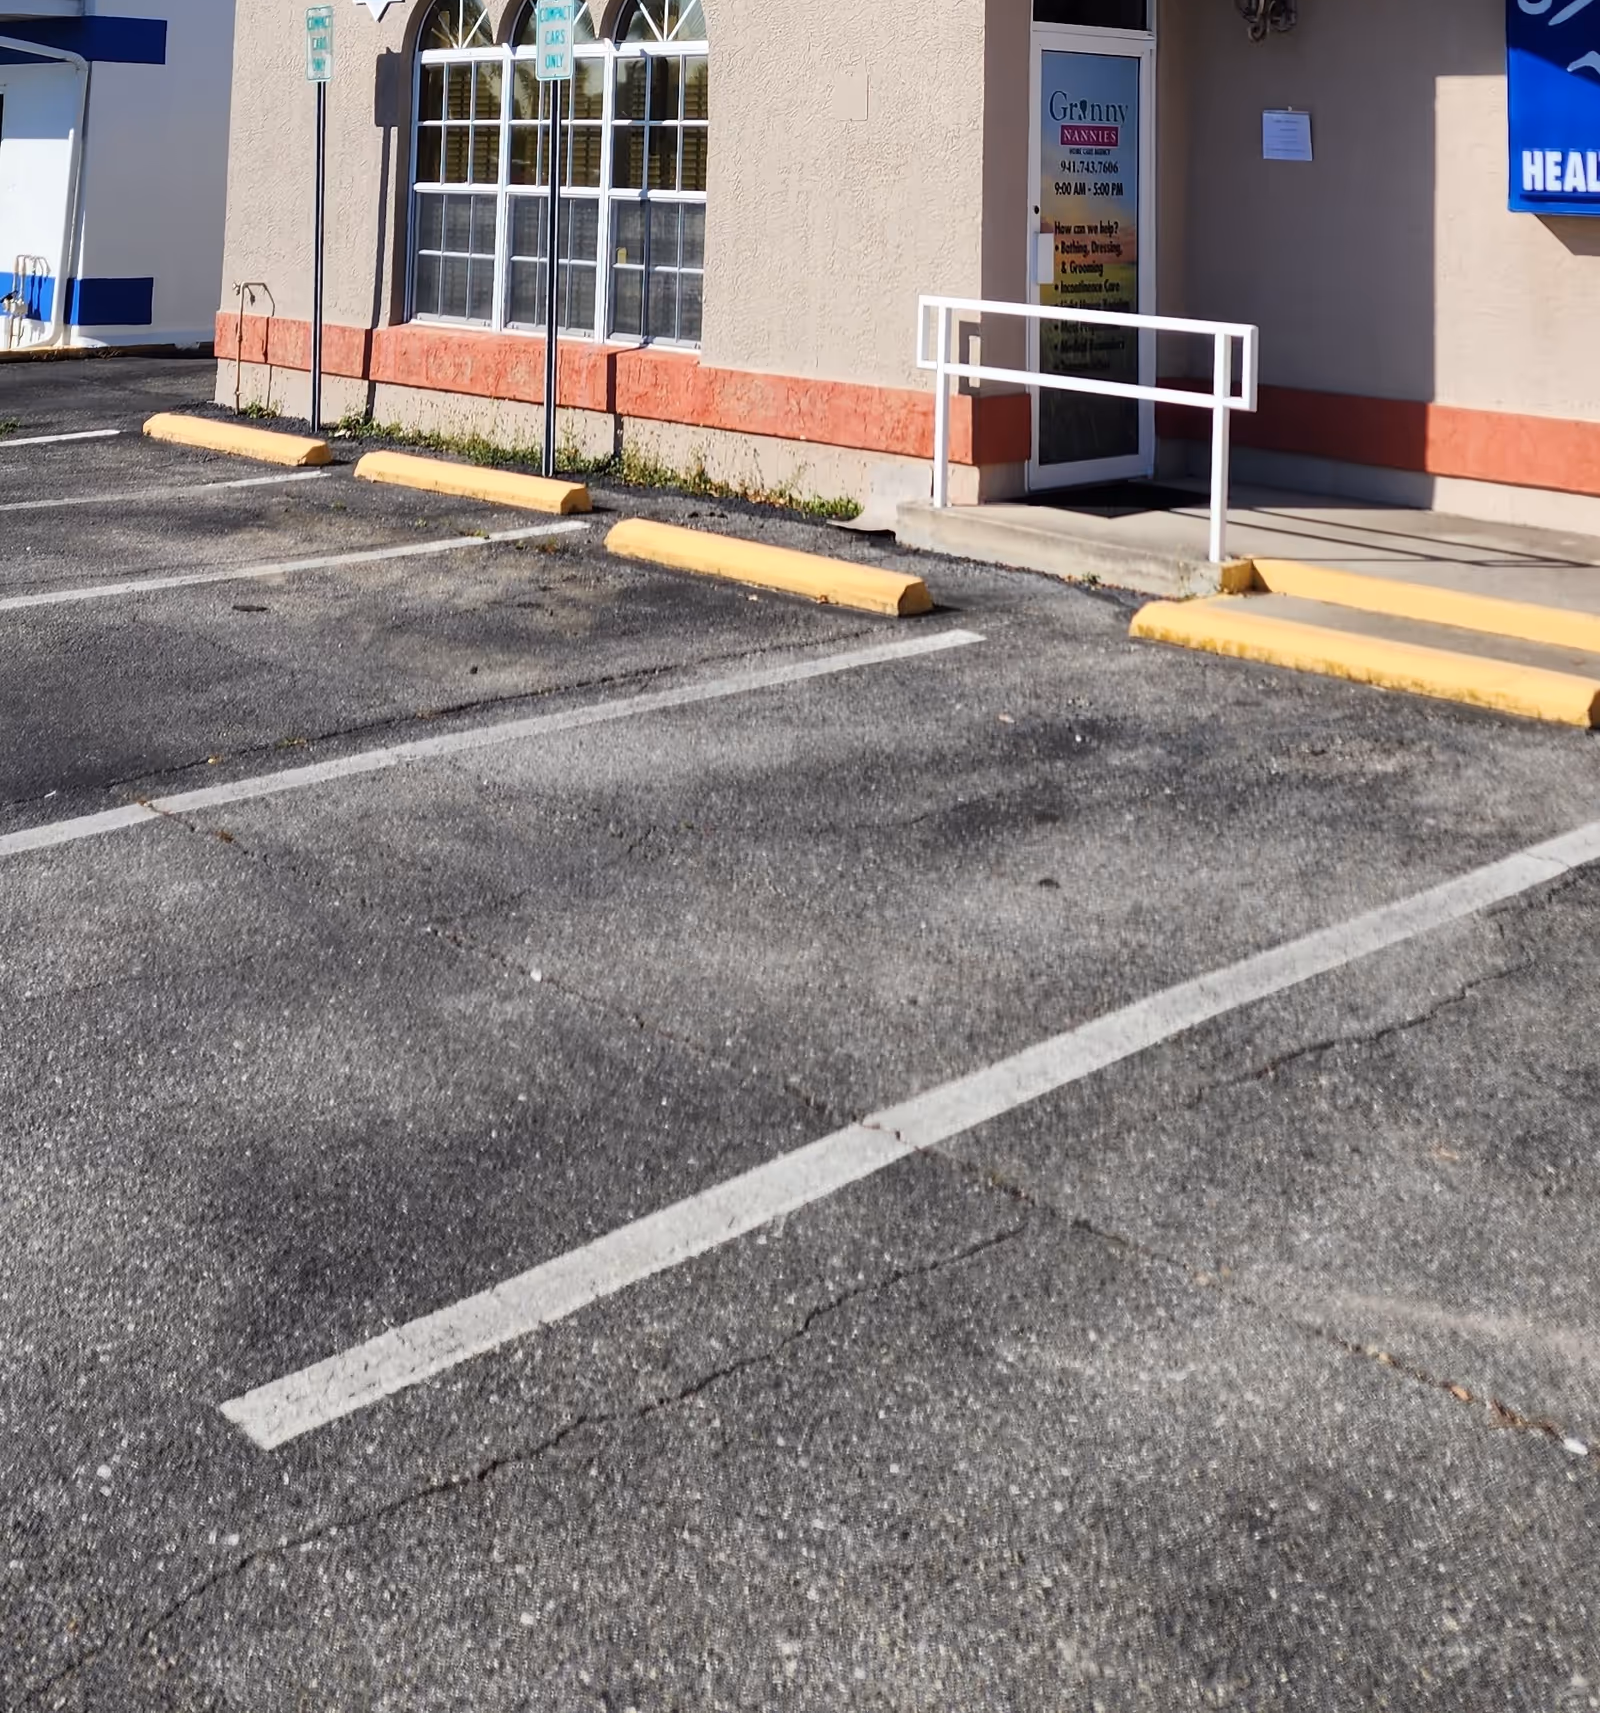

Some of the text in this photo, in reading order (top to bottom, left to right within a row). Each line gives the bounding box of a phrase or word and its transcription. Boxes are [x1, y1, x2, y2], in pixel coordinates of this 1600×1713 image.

[540, 6, 572, 22] COMPACT
[545, 29, 565, 45] CARS
[545, 53, 564, 69] ONLY
[1049, 90, 1128, 127] Grnny
[1063, 128, 1116, 143] NANNIES
[1060, 160, 1119, 174] 941.743.7606
[1522, 150, 1600, 192] HEAL
[1054, 182, 1072, 196] 9:00
[1073, 182, 1086, 196] AM
[1093, 182, 1110, 196] 5:00
[1111, 182, 1124, 196] PM
[1055, 221, 1119, 237] How can we help?
[1061, 240, 1123, 258] Bathing, Dressing,
[1061, 261, 1104, 277] & Grooming
[1061, 279, 1120, 293] Incontinence Care
